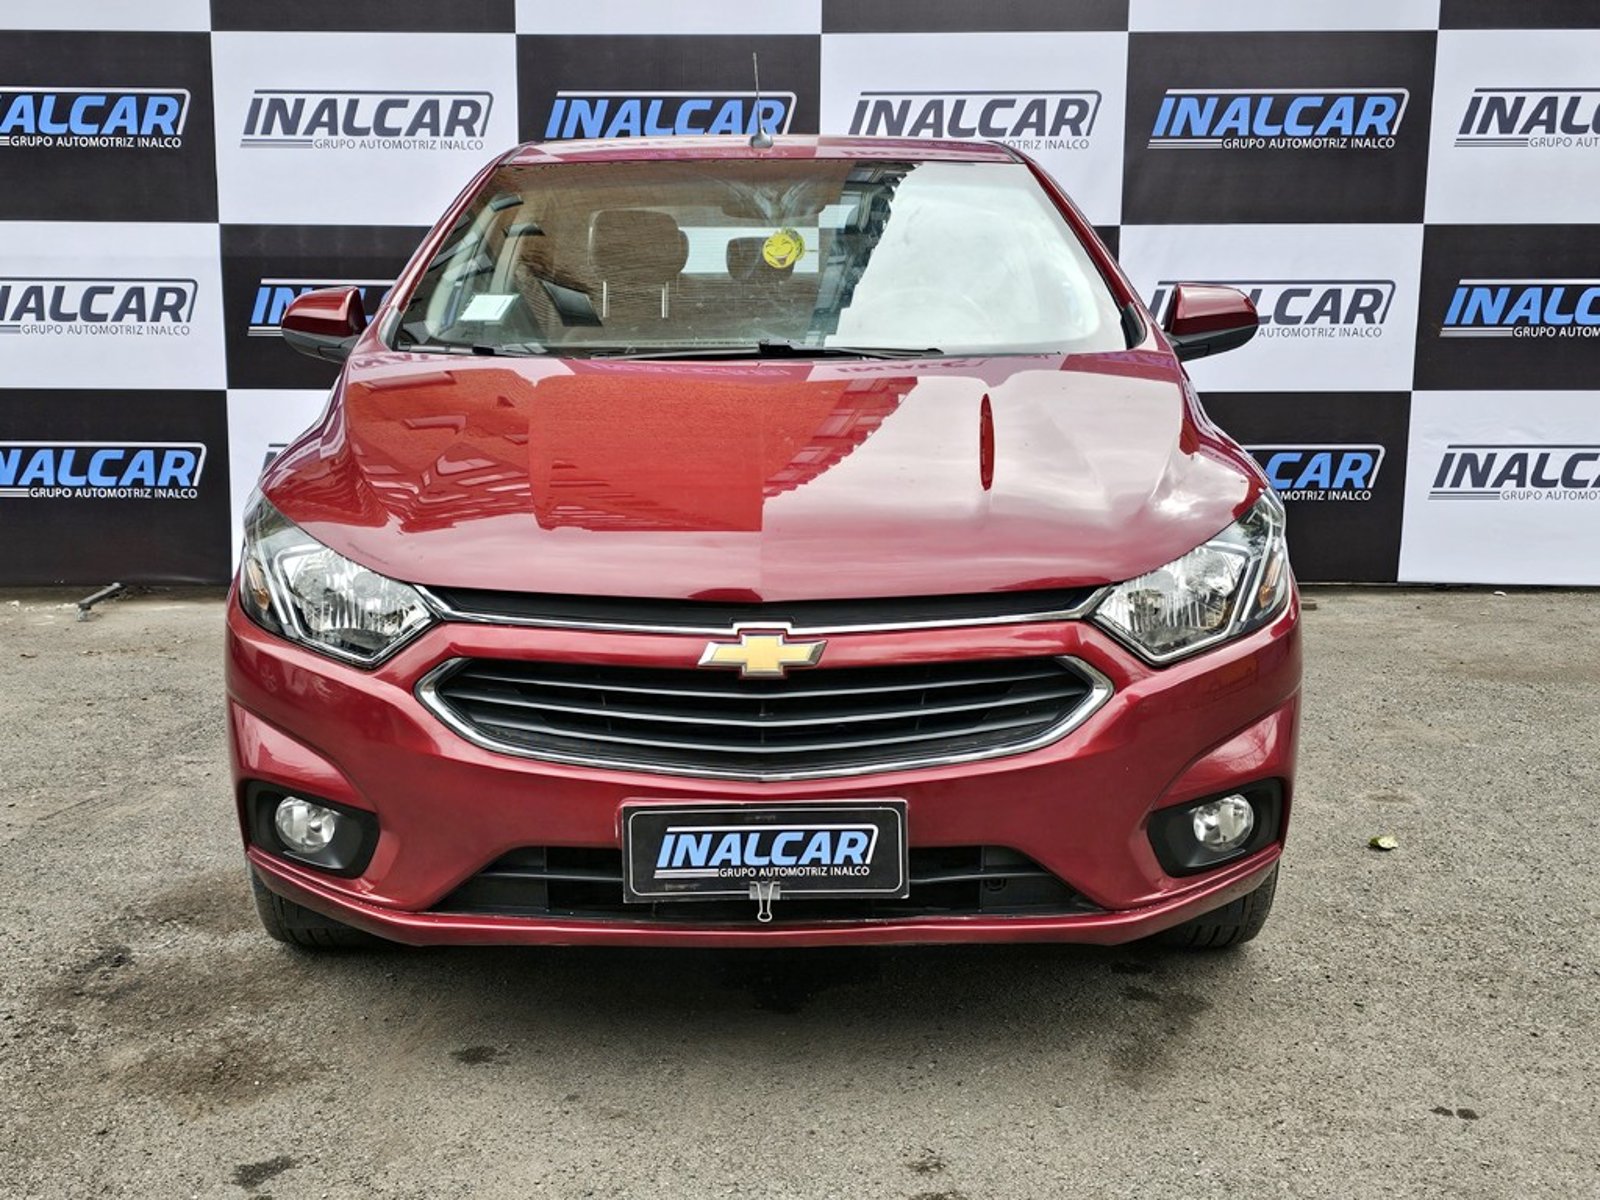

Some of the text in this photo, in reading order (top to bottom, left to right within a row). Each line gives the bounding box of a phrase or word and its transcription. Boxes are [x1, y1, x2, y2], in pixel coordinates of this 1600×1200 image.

[0, 95, 179, 135] ALCAR
[243, 98, 482, 137] INALCAR
[545, 99, 786, 138] INALCAR
[848, 98, 1090, 138] INALCAR
[1151, 96, 1397, 137] INALCAR
[1459, 96, 1600, 135] INAL
[10, 135, 182, 149] GRUPO AUTOMOTRIZ INALCO
[314, 138, 484, 150] GRUPO AUTOMOTRIZ INALCO
[1045, 139, 1090, 150] INALCO
[1223, 137, 1396, 149] GRUPO AUTOMOTRIZ INALCO
[1529, 137, 1573, 147] GRUPO
[1443, 287, 1600, 325] INALC
[22, 324, 190, 336] GRUPO AUTOMOTRIZ INALCO
[1258, 327, 1382, 338] AUTOMOTRIZ INALCO
[1513, 326, 1556, 337] GRUPO
[1264, 452, 1373, 489] CAR
[1432, 452, 1600, 488] INALC
[30, 487, 198, 499] GRUPO AUTOMOTRIZ INALCO
[1278, 490, 1372, 501] MOTRIZ INALCO
[1501, 490, 1600, 500] GRUPO AUTOMO
[656, 831, 870, 868] INALCAR
[719, 865, 870, 877] GRUPO AUTOMOTRIZ INALCO
